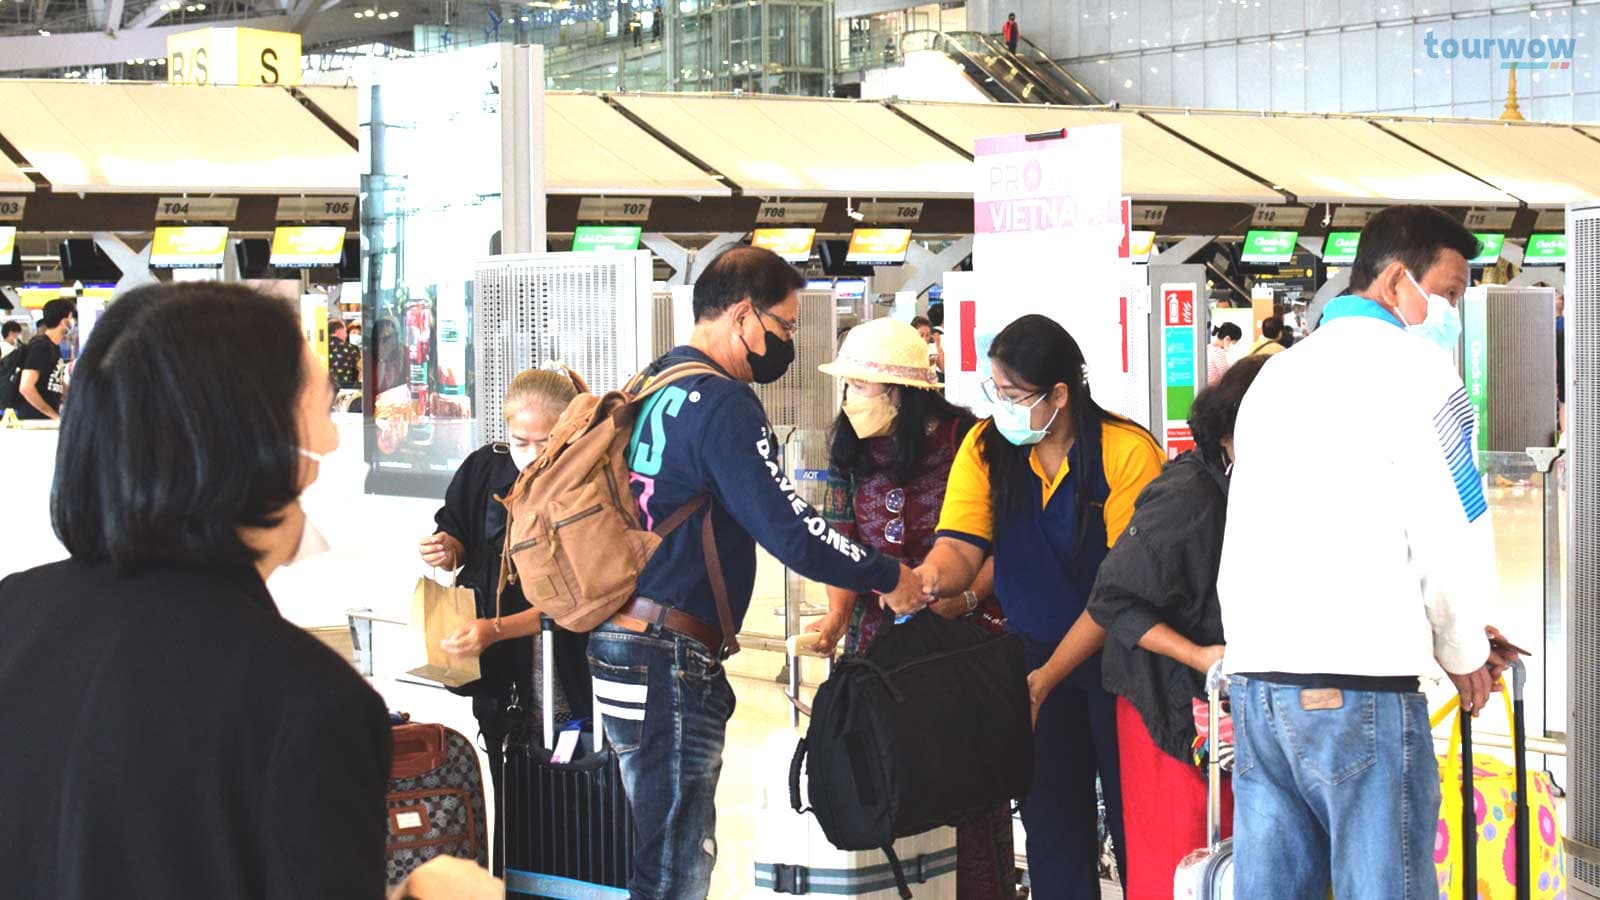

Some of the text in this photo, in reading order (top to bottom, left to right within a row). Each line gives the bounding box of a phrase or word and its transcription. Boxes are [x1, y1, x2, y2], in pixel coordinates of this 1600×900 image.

[261, 48, 279, 85] S
[0, 202, 18, 215] 03
[164, 203, 189, 214] T04
[324, 203, 350, 214] T05
[623, 203, 646, 215] T07
[763, 207, 785, 218] T08
[896, 207, 918, 217] T09
[989, 197, 1098, 233] VIETNA
[1144, 209, 1162, 220] T11
[1257, 211, 1276, 221] T12
[1468, 214, 1486, 224] T15
